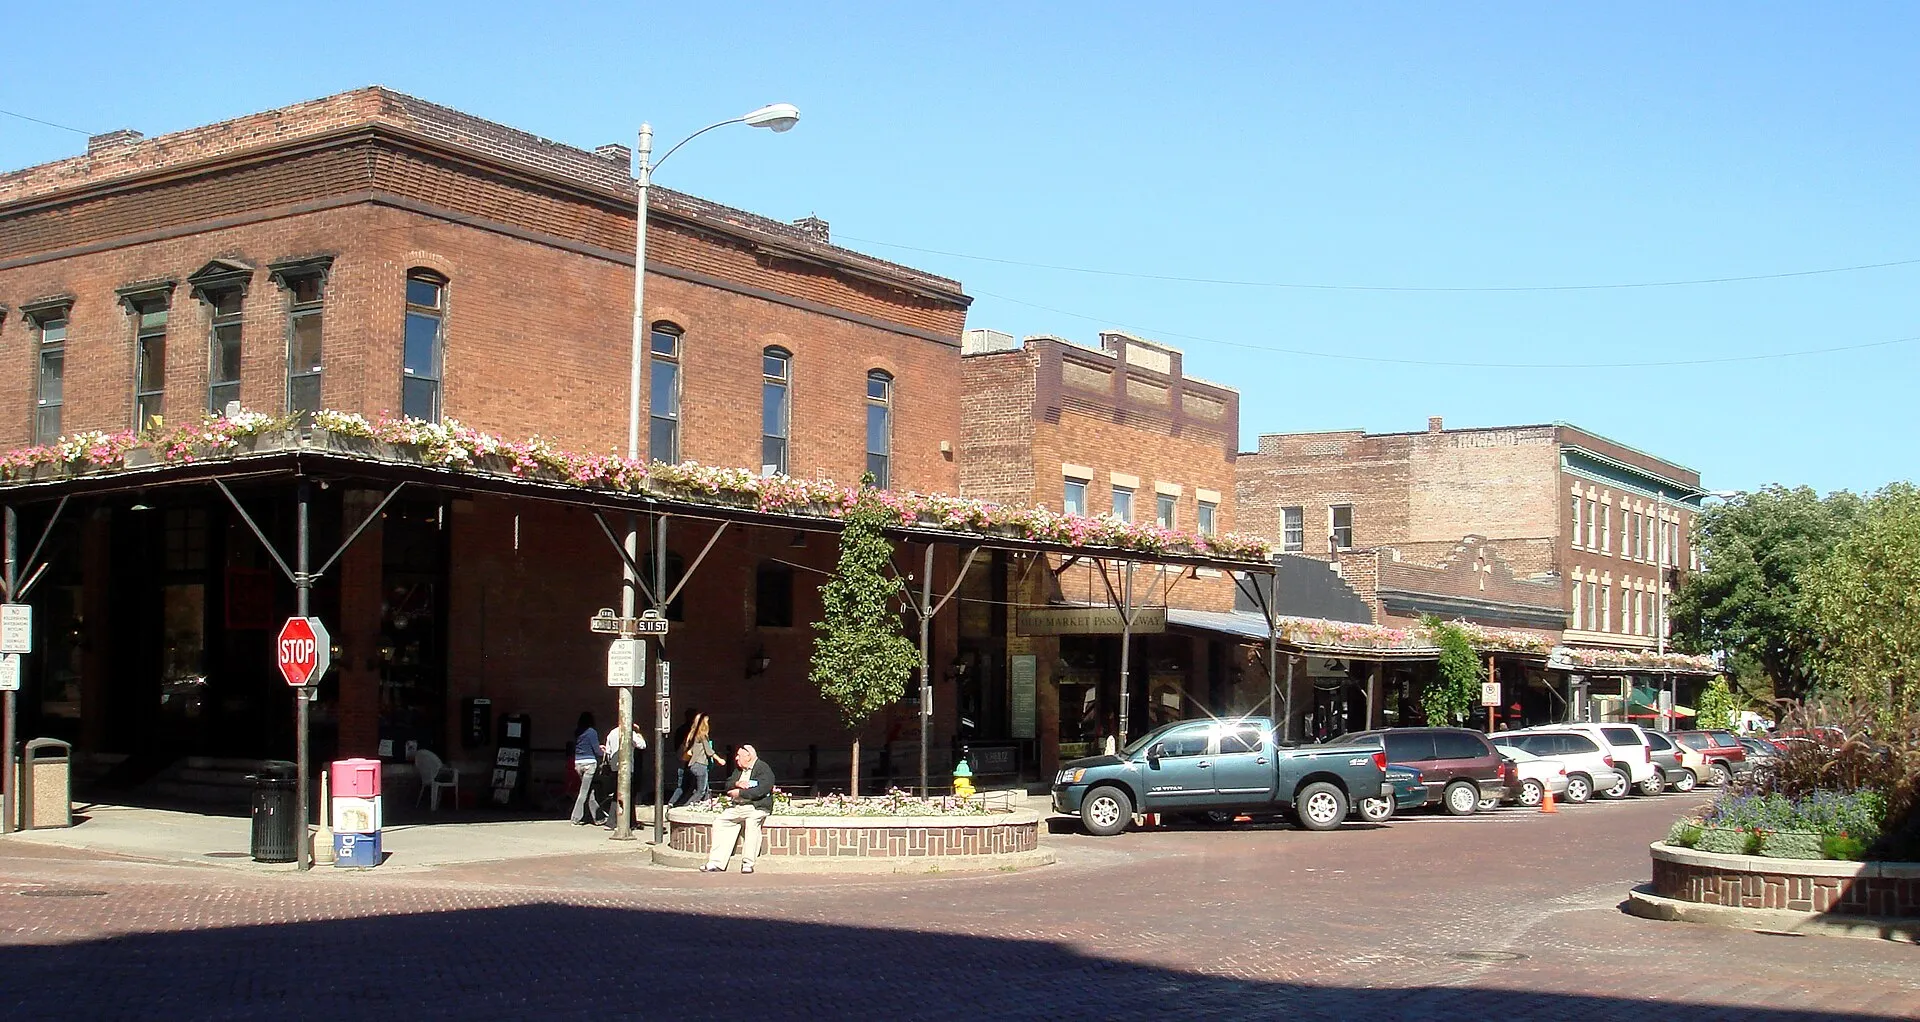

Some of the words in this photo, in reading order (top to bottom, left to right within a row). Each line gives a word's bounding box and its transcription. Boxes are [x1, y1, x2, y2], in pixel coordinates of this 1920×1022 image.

[1020, 617, 1043, 627] OLD
[1046, 616, 1090, 627] MARKET
[1094, 616, 1161, 627] PASSAEWAY
[281, 638, 315, 664] STOP
